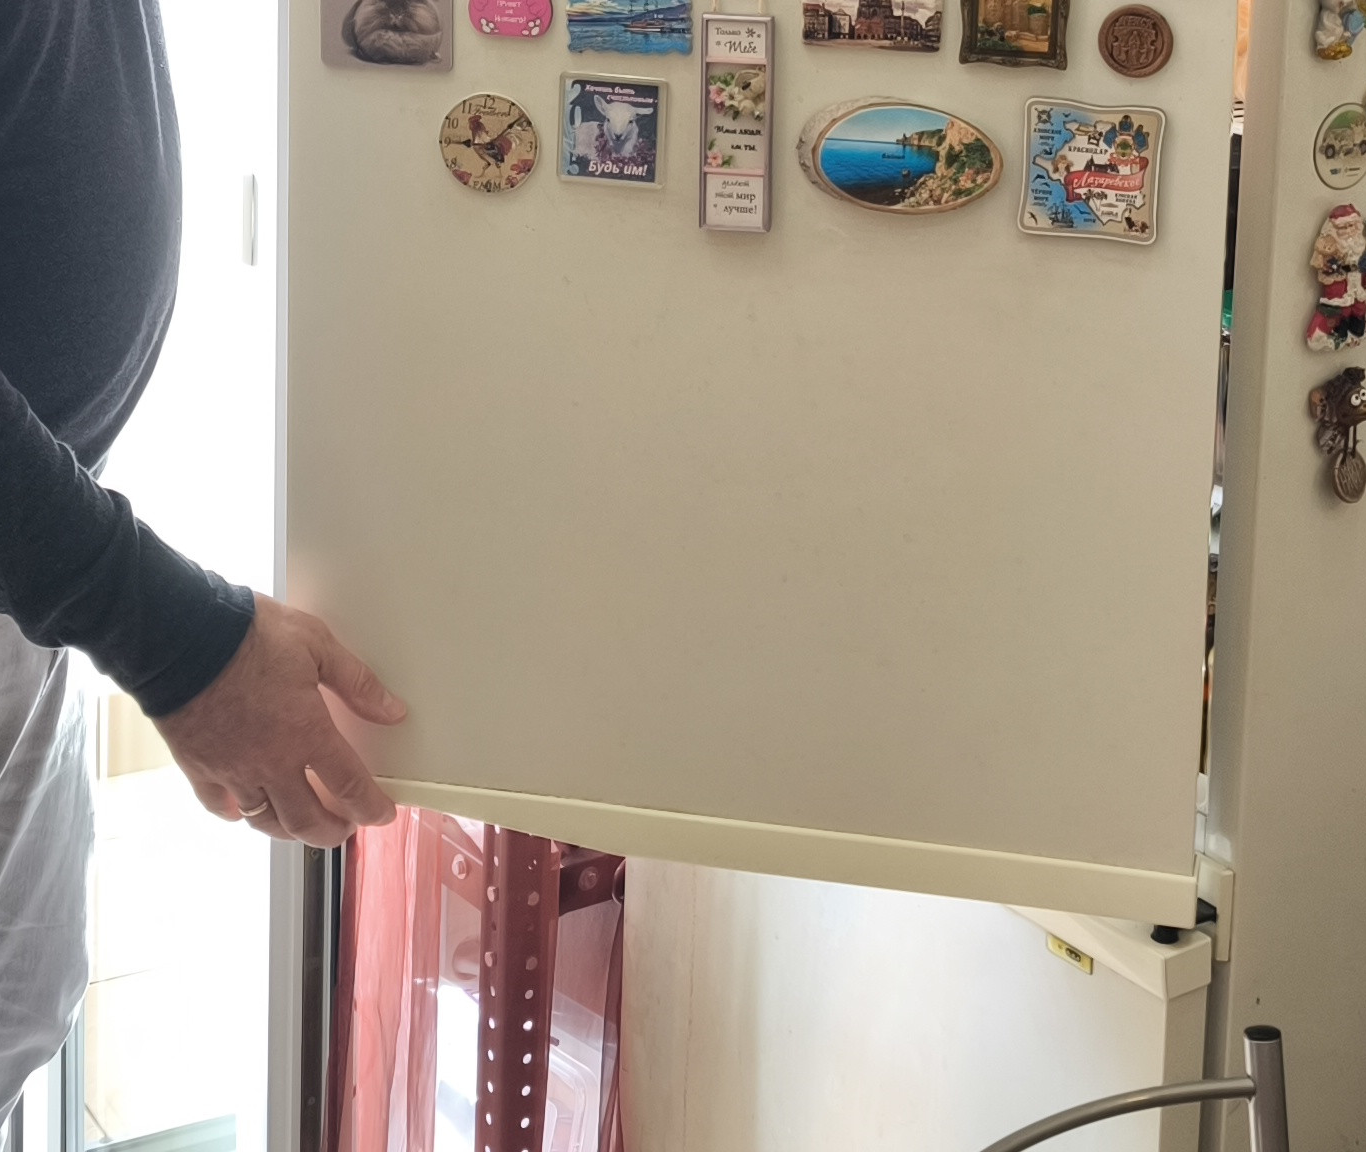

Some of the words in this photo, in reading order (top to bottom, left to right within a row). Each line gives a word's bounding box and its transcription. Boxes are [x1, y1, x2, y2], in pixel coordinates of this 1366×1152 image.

[1068, 146, 1108, 155] КРАСНОДАР
[588, 160, 620, 175] Будь
[623, 164, 648, 176] им!
[735, 192, 756, 203] мир
[723, 204, 757, 215] лучше!
